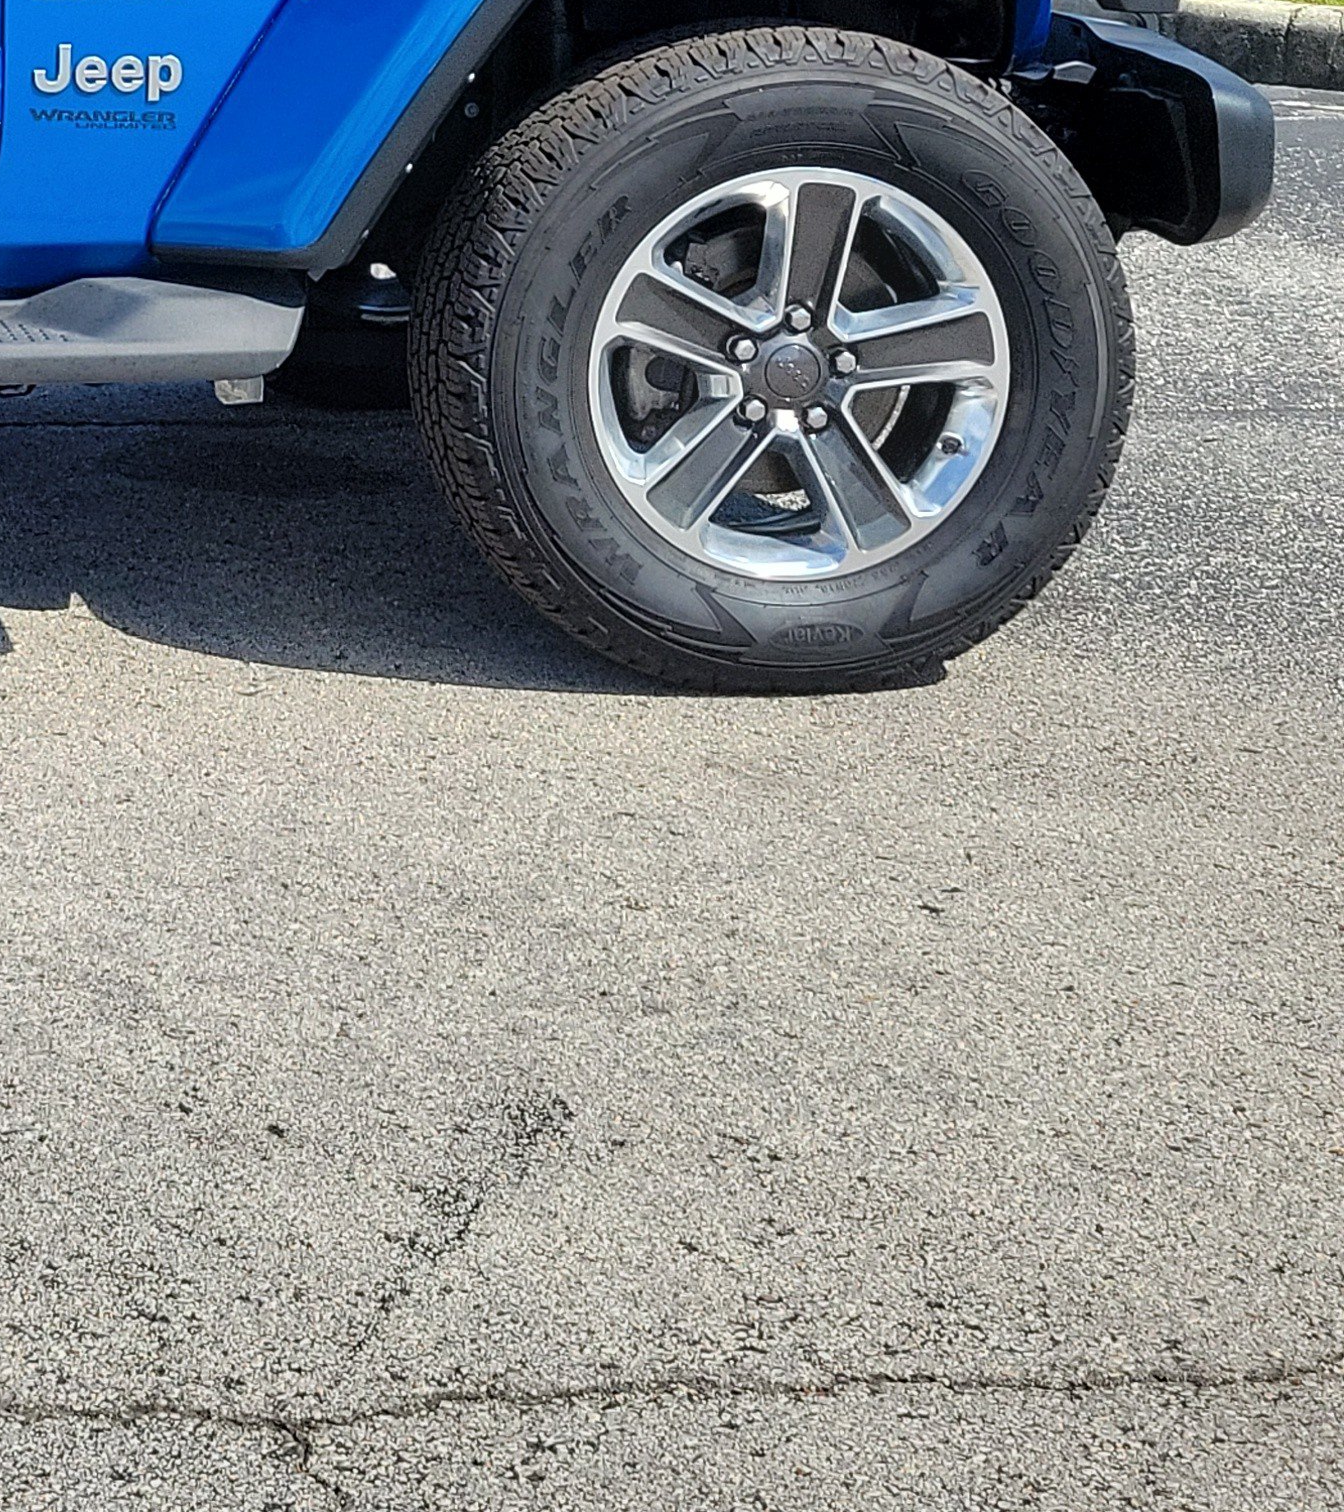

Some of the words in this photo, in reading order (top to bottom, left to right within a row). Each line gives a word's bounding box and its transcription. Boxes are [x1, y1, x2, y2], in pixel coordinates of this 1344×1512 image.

[33, 43, 182, 101] Jeep
[29, 107, 176, 123] WRANGLER
[75, 121, 176, 131] UNLIMITED
[961, 169, 1079, 568] GOODYEAR
[537, 194, 644, 586] WRANGLER
[783, 624, 854, 644] Kevlar
